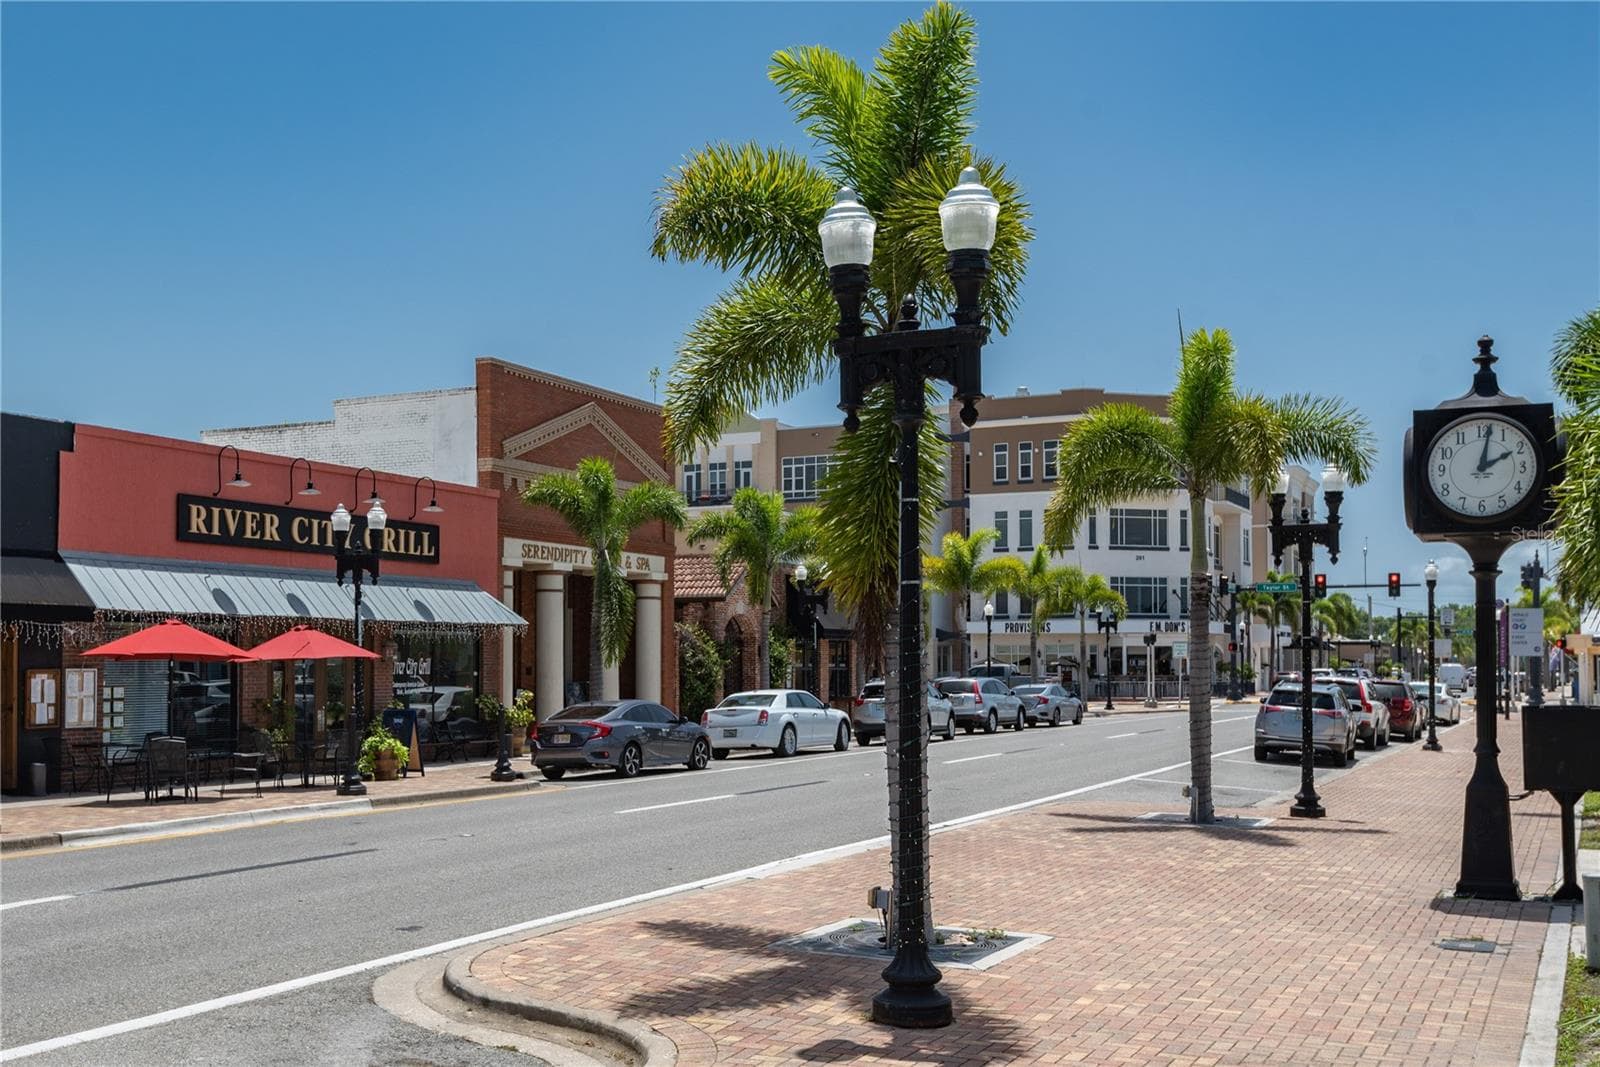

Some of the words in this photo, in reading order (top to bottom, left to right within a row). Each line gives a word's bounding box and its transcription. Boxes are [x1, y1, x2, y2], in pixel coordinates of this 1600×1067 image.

[1456, 432, 1465, 445] 11
[1501, 429, 1506, 441] 1
[1441, 447, 1453, 460] 10
[1516, 441, 1525, 454] 2
[1438, 464, 1446, 477] 9
[1519, 461, 1527, 473] 3
[1441, 483, 1450, 496] 8
[1514, 481, 1522, 494] 4
[1459, 497, 1467, 510] 7
[1478, 500, 1486, 513] 6
[1498, 495, 1506, 508] 5
[187, 503, 281, 542] RIVER
[291, 516, 356, 550] CITY
[521, 543, 588, 564] SERENDIPITY
[625, 555, 632, 569] &
[636, 556, 651, 571] SPA
[1005, 622, 1051, 633] PROVISNS
